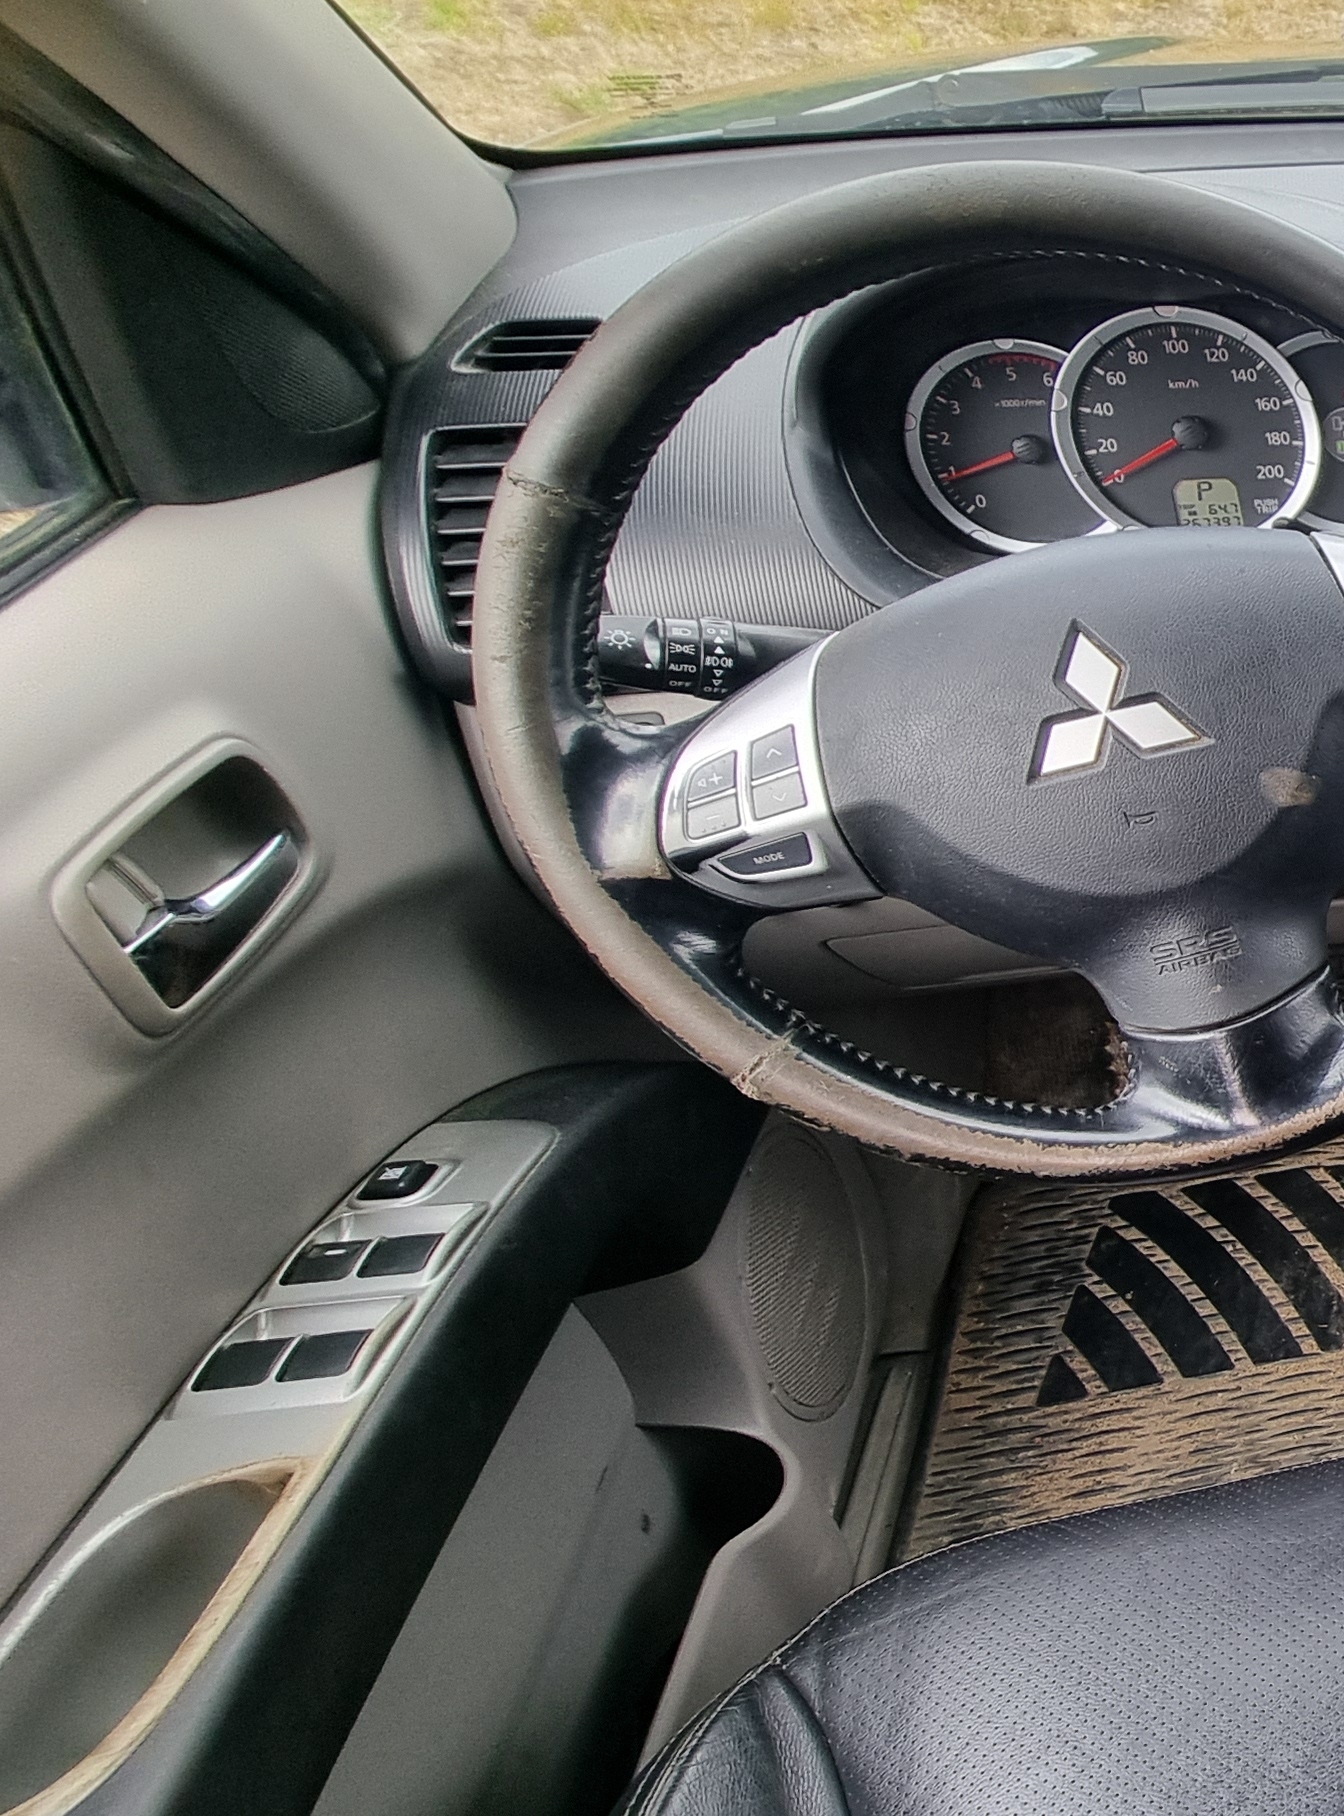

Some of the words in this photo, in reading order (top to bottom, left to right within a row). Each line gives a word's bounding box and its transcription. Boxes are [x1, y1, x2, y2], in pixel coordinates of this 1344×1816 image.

[1162, 339, 1189, 355] 100
[1127, 350, 1148, 365] 80
[1204, 347, 1229, 363] 120
[1006, 367, 1017, 381] 5
[1042, 371, 1053, 387] 6
[1106, 371, 1126, 386] 60
[1230, 368, 1257, 382] 140
[971, 376, 982, 389] 4
[1167, 378, 1200, 390] km/h
[950, 400, 960, 415] 3
[1092, 402, 1114, 417] 40
[1255, 397, 1280, 412] 160
[939, 431, 950, 446] 2
[1097, 438, 1117, 453] 20
[1264, 431, 1290, 446] 180
[1256, 464, 1285, 480] 200
[1196, 481, 1212, 501] P
[975, 494, 986, 508] 0
[668, 663, 697, 673] AUTO
[703, 686, 729, 694] OFF
[752, 851, 785, 865] MODE
[1150, 926, 1237, 961] SRS
[1158, 944, 1242, 975] AIRBAG
